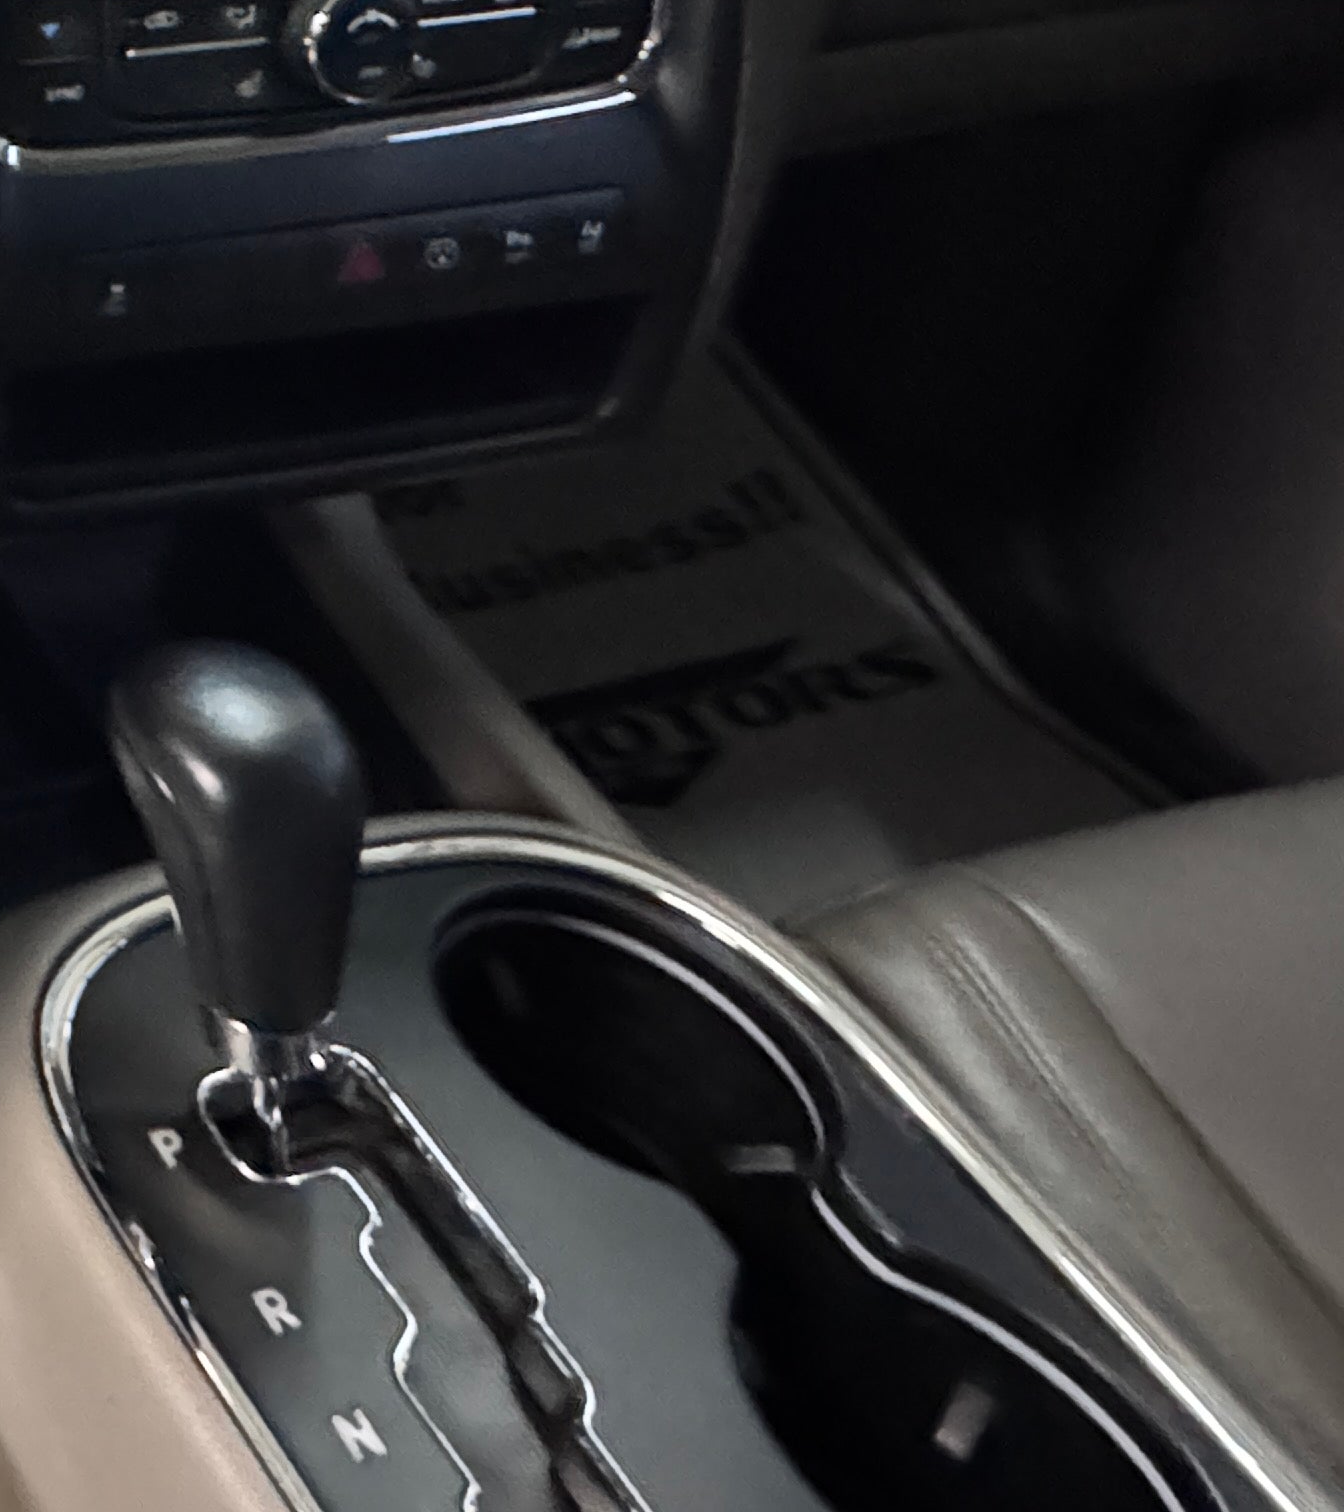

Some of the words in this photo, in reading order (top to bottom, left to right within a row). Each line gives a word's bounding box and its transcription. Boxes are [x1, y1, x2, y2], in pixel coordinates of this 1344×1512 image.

[148, 1127, 183, 1169] P
[252, 1287, 302, 1336] R
[331, 1408, 387, 1463] N
